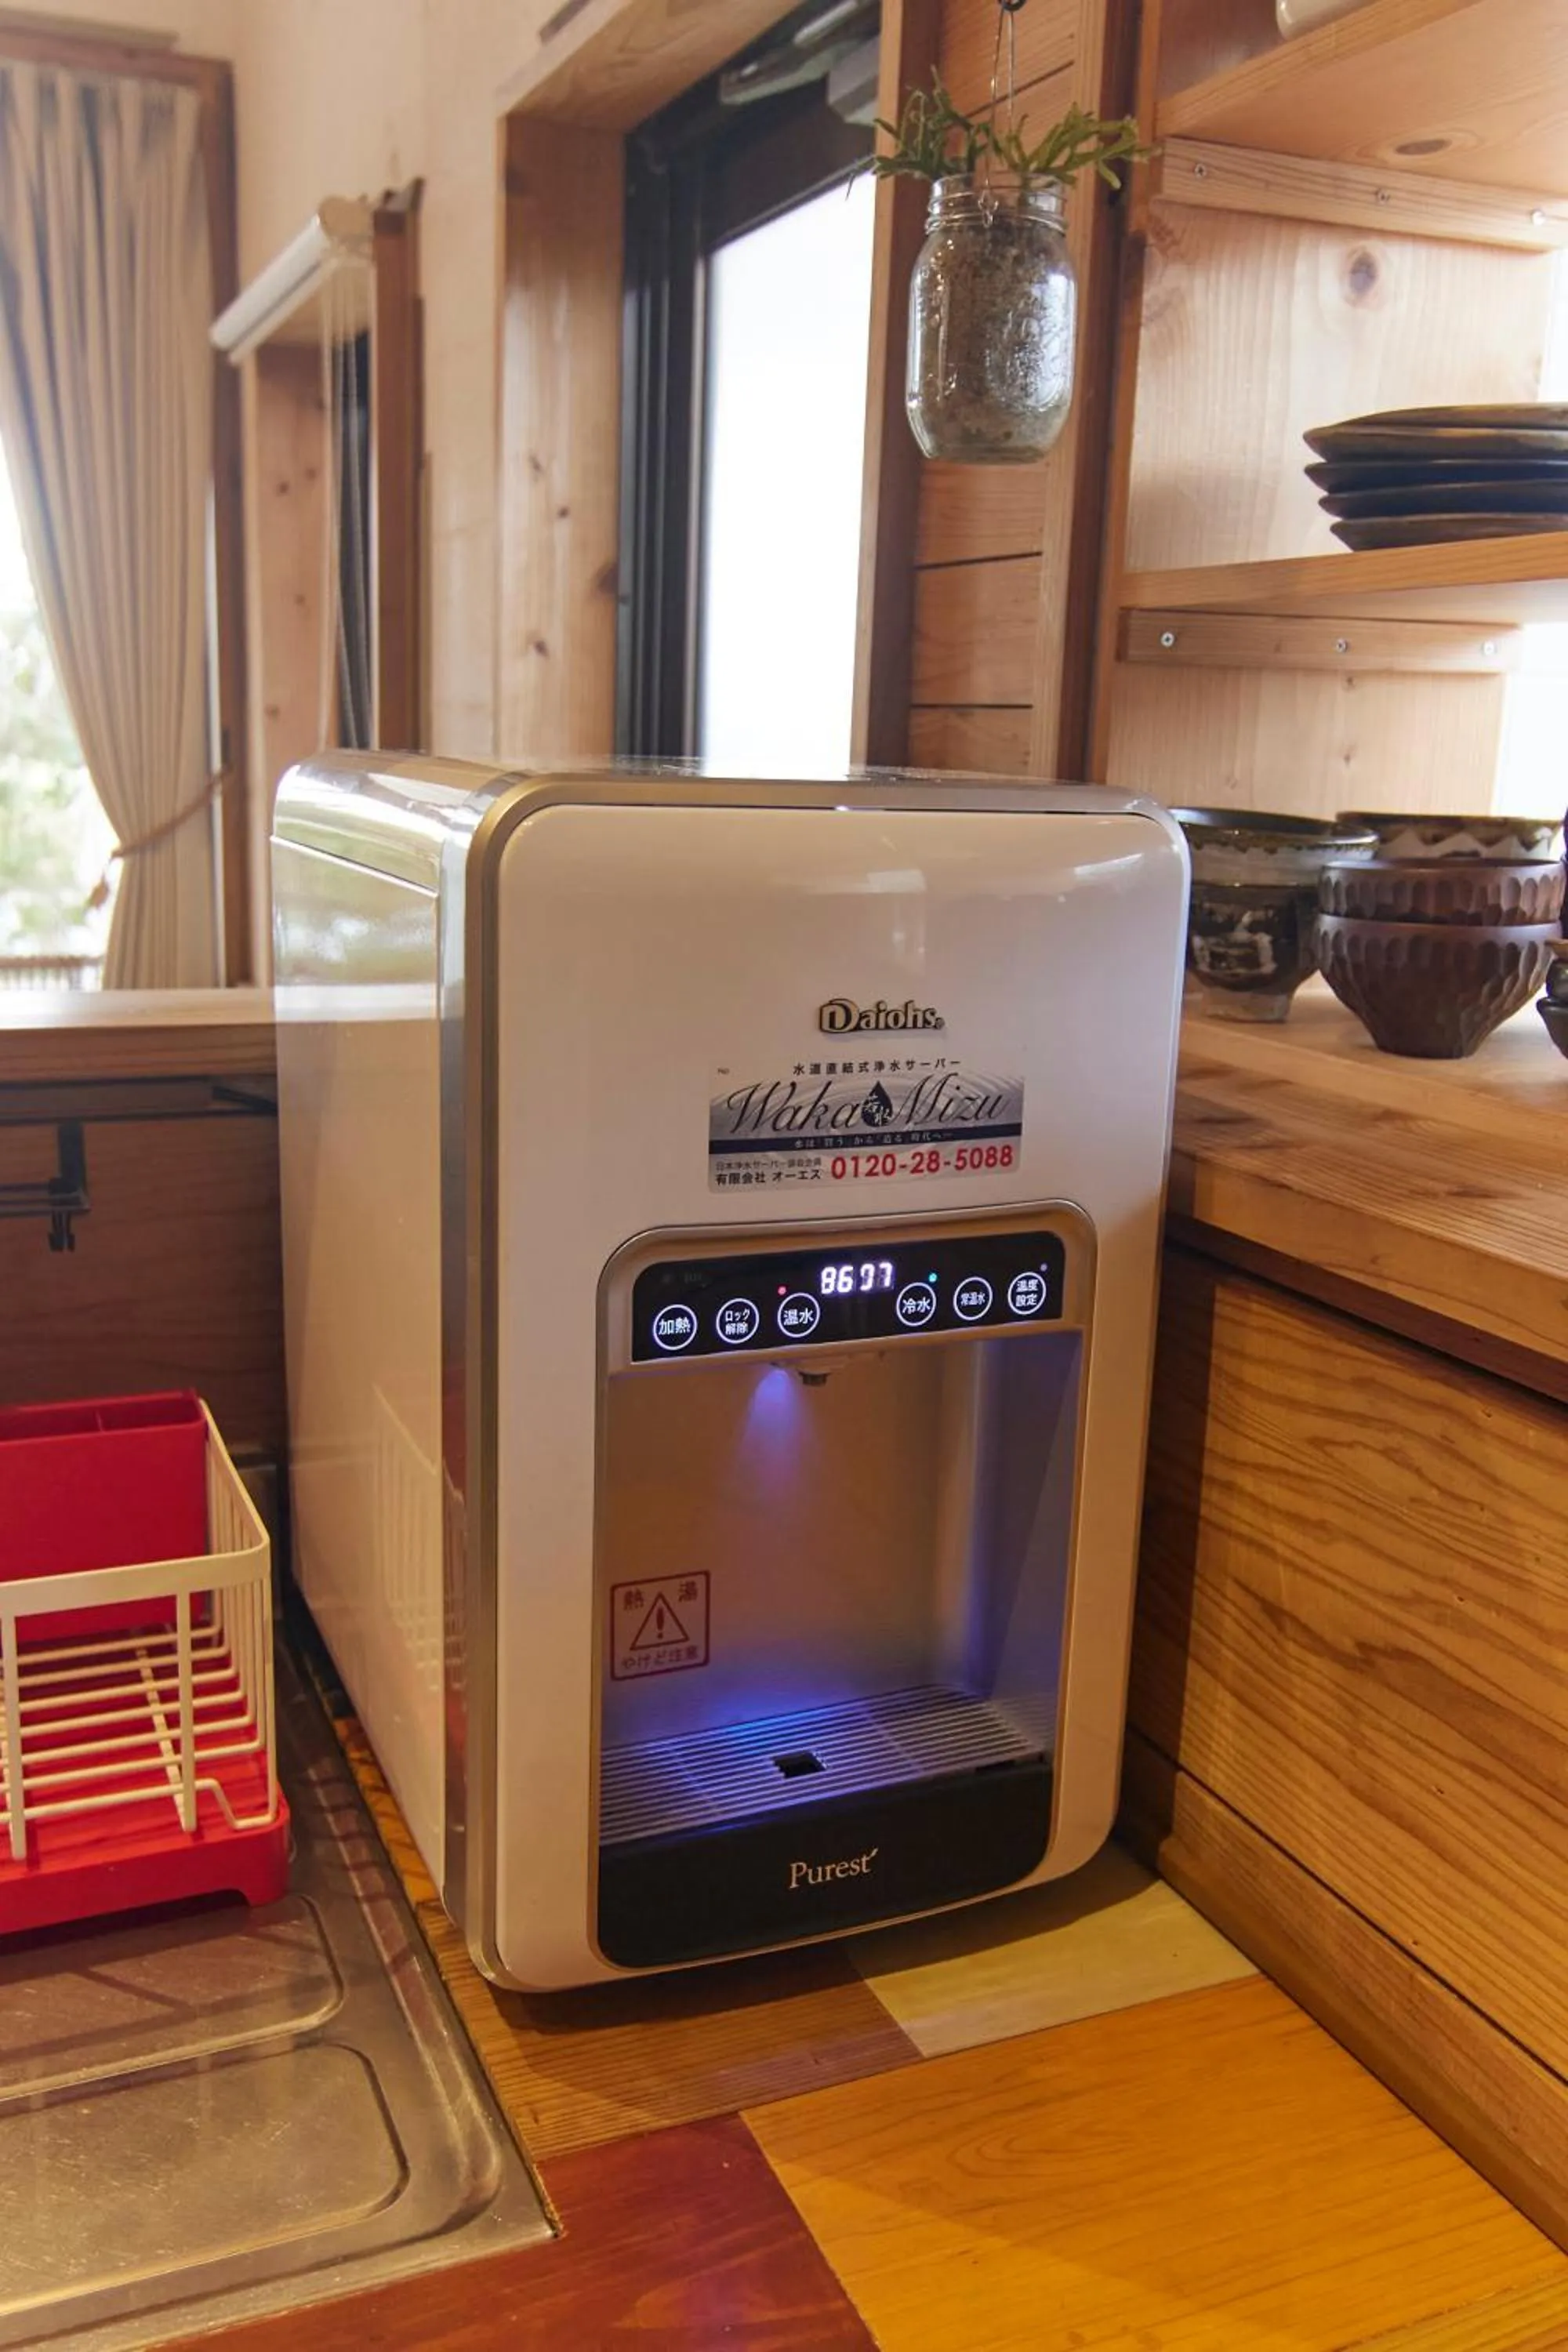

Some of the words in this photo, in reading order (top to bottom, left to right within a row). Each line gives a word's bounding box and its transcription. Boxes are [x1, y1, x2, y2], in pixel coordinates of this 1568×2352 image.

[820, 998, 938, 1033] Daiohs
[727, 1080, 861, 1134] Waka
[891, 1072, 1004, 1126] Mizu
[831, 1145, 1014, 1181] 0120-28-5088
[717, 1171, 766, 1185] 有限会社
[771, 1169, 821, 1181] オーエス
[725, 1308, 750, 1322] ロック
[902, 1297, 931, 1315] 冷水
[658, 1316, 691, 1335] 加熱
[784, 1307, 814, 1326] 温水
[725, 1321, 749, 1335] 解除
[789, 1848, 878, 1889] Purest
